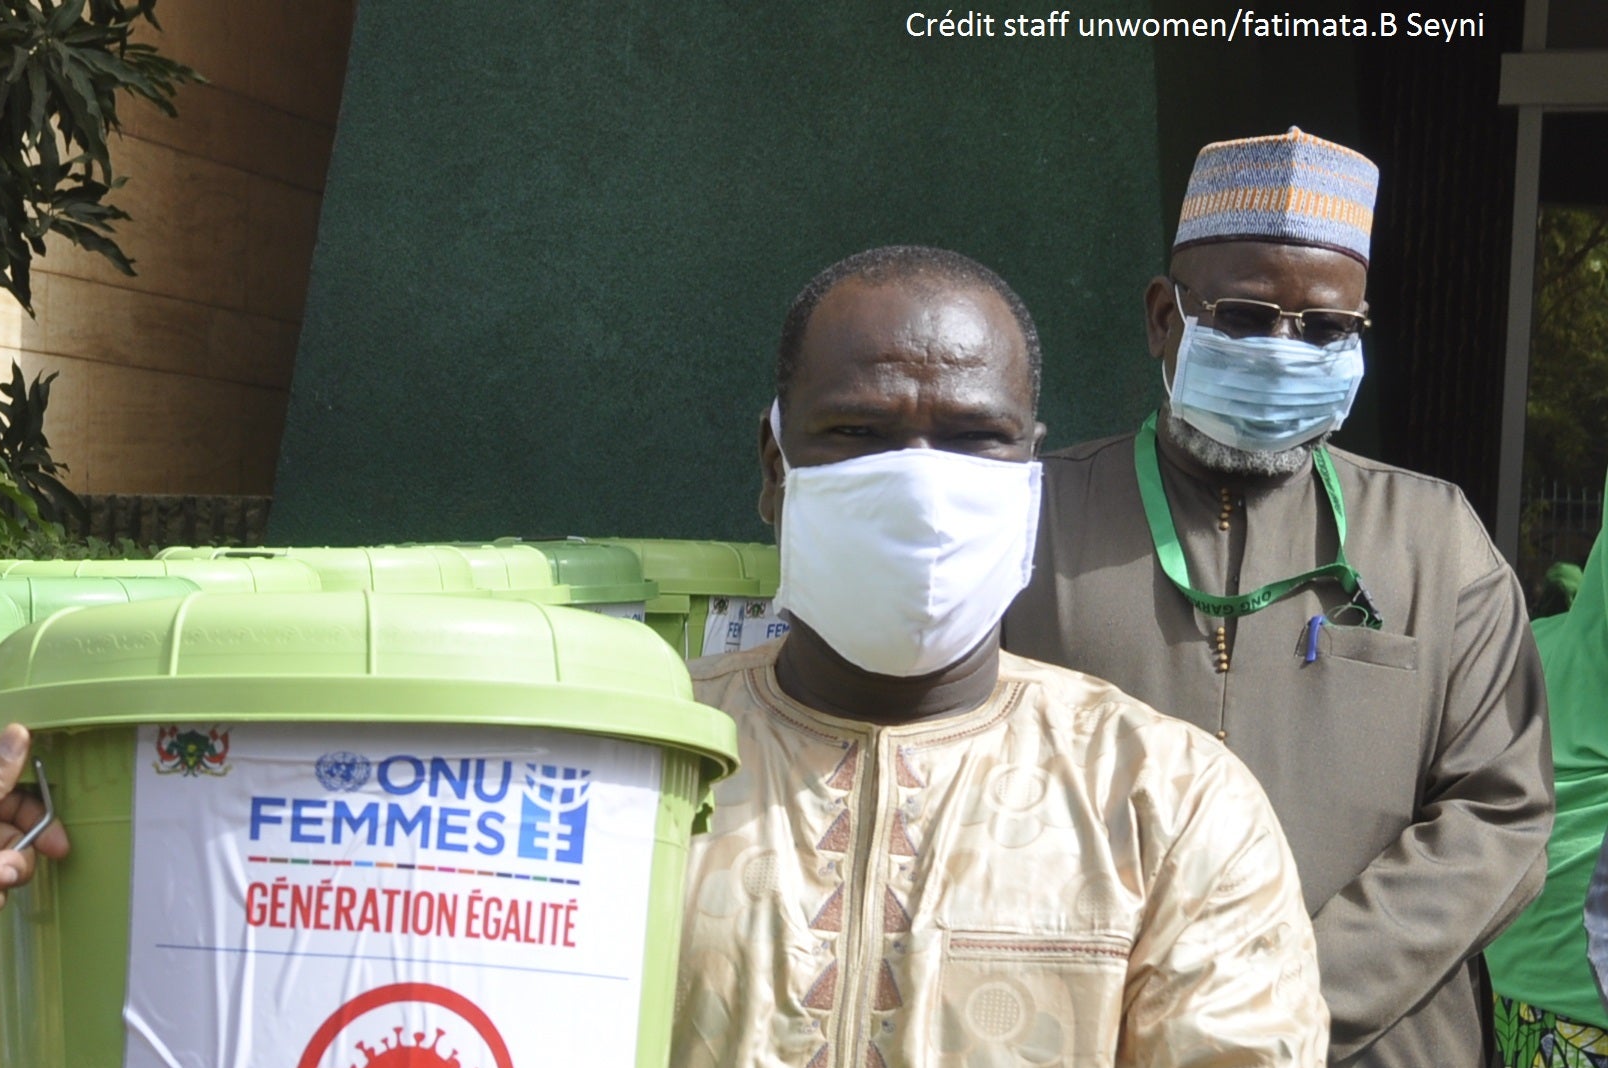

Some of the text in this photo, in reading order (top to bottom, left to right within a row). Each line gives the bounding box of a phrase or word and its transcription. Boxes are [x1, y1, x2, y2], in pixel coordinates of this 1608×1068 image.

[1240, 590, 1272, 613] ONG
[377, 755, 513, 803] ONU
[249, 796, 506, 856] FEMMES
[246, 876, 578, 948] GÉNÉRATION ÉGALITÉ
